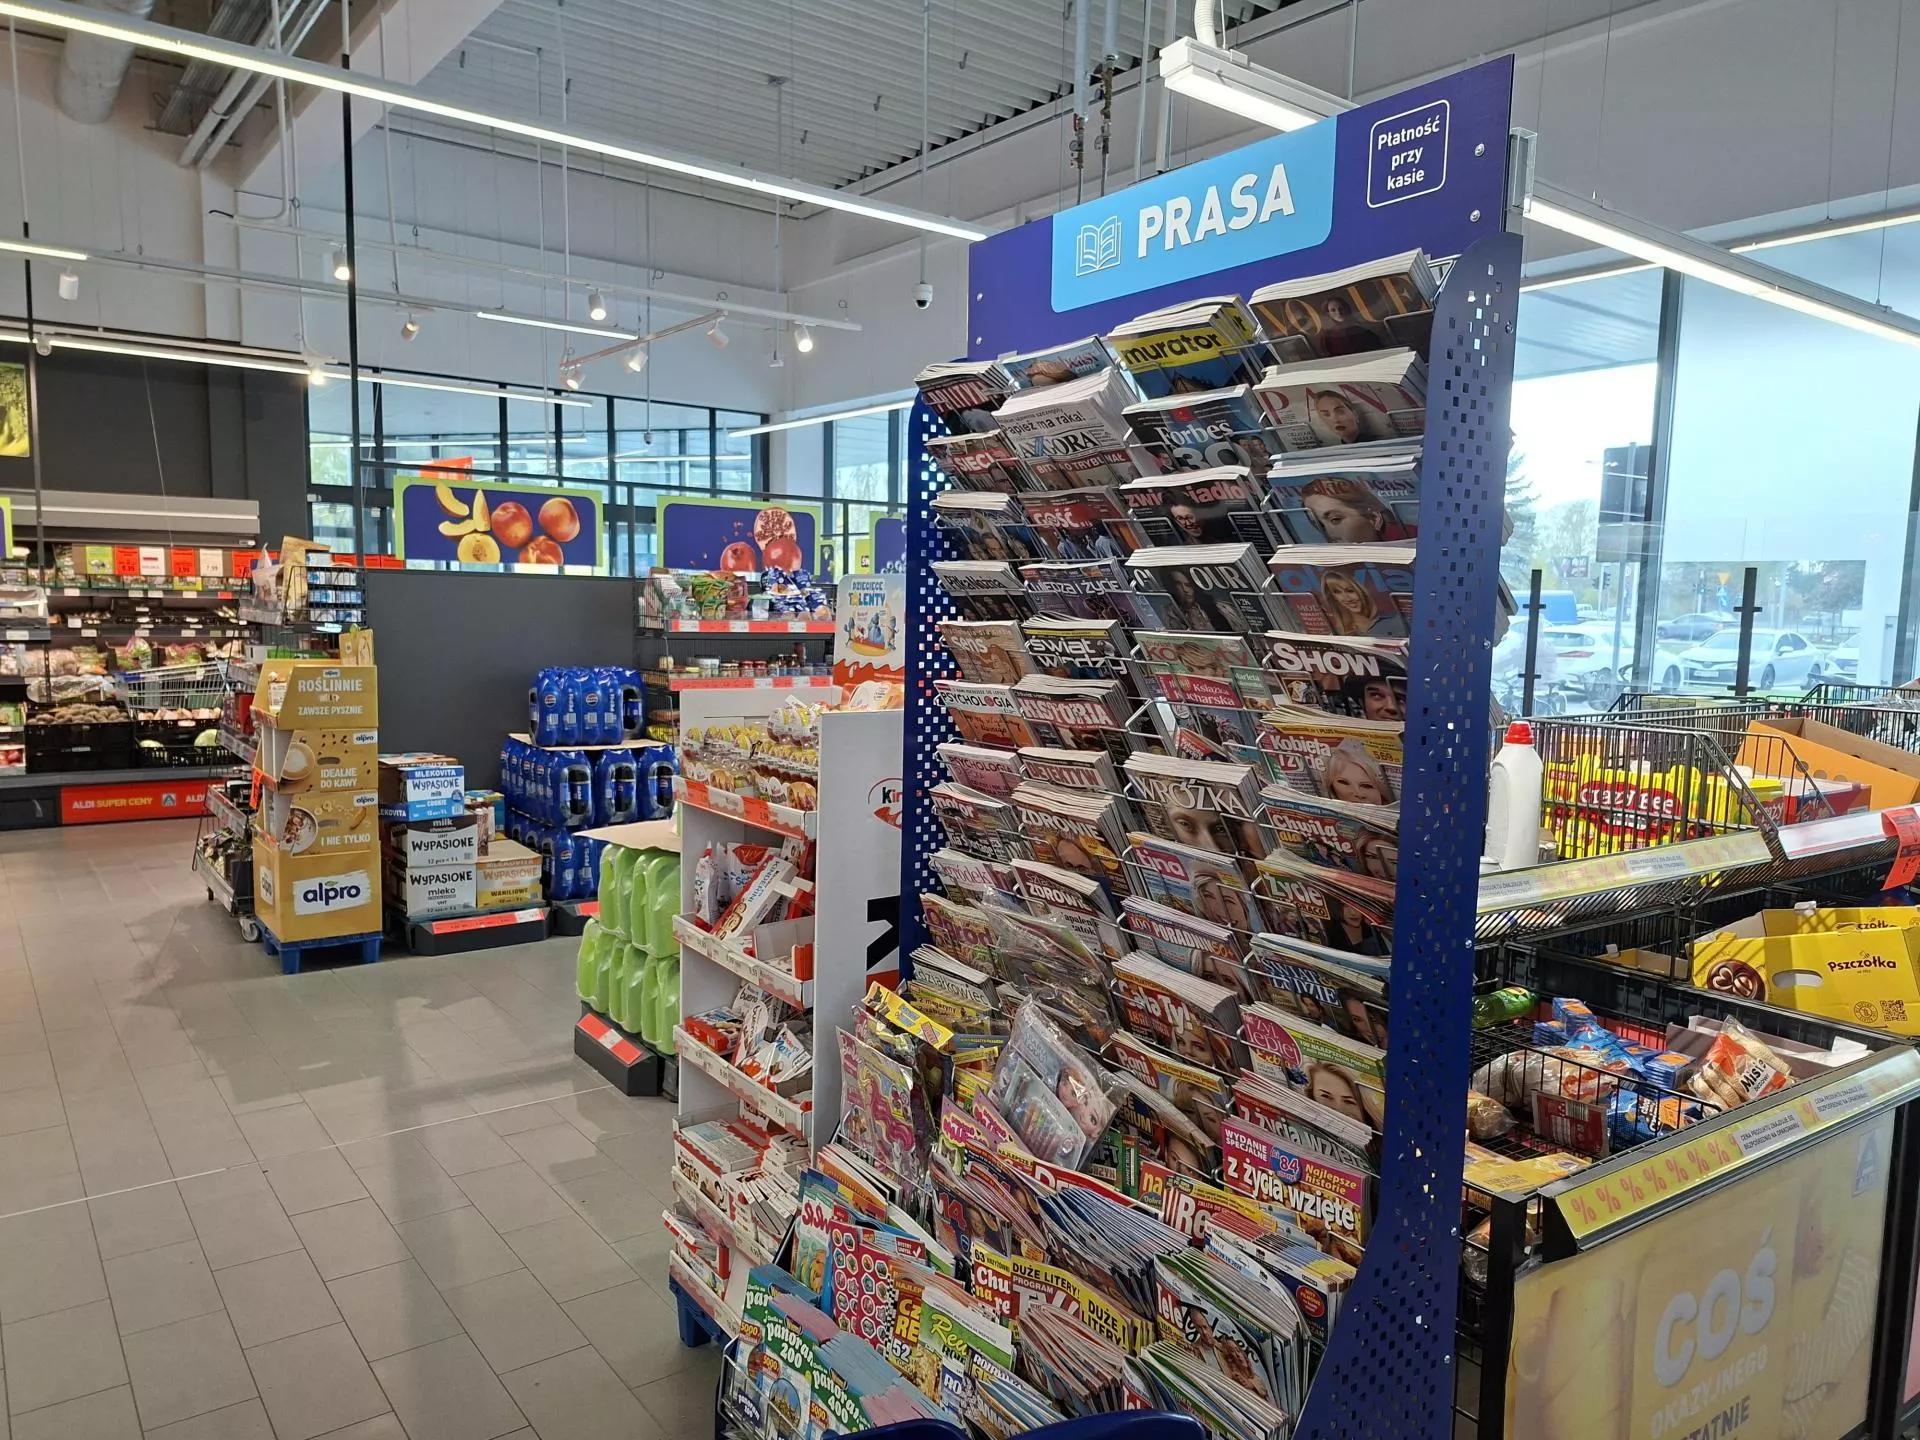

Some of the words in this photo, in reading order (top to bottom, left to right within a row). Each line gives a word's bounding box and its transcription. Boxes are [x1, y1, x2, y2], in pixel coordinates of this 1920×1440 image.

[1377, 114, 1440, 150] Płatność
[1391, 147, 1423, 171] przy
[1387, 168, 1425, 190] kasie
[1137, 163, 1296, 259] PRASA
[1256, 274, 1433, 337] VOUE
[1124, 331, 1222, 366] murator
[926, 381, 997, 413] POLITYK
[1001, 419, 1037, 438] Papież
[1038, 418, 1055, 431] ma
[1056, 409, 1087, 428] raka!
[1153, 420, 1233, 450] Forbes
[955, 452, 995, 473] SIECI
[1033, 507, 1080, 529] GOŚĆ
[951, 636, 988, 654] sens
[1273, 642, 1381, 677] SHOW
[298, 677, 363, 693] ROŚLINNIE
[298, 706, 330, 716] ZAWSZE
[331, 705, 364, 715] PYSZNIE
[1019, 698, 1115, 726] HISTORIA
[355, 733, 375, 743] alpro
[1270, 735, 1332, 757] Kobieta
[320, 767, 357, 778] IDEALNE
[415, 769, 457, 778] MLEKOVITA
[949, 756, 1013, 773] PSYCHOLOGIA
[1027, 763, 1100, 786] DETEKTYW
[320, 779, 332, 788] DO
[333, 778, 358, 788] KAWY
[72, 800, 95, 809] ALDI
[96, 799, 127, 808] SUPER
[128, 797, 153, 806] CENY
[356, 796, 375, 805] alpro
[1138, 775, 1251, 818] WRÓŻKA
[380, 808, 407, 817] EKOVITA
[432, 818, 453, 827] milk
[1016, 805, 1107, 842] ZDROWIE
[1272, 814, 1338, 837] Chwila
[326, 835, 341, 846] NIE
[343, 833, 371, 844] TYLKO
[1137, 847, 1186, 879] tina
[428, 887, 456, 897] mleko
[747, 860, 781, 903] KINDERINI
[1265, 872, 1324, 906] Życie
[302, 882, 361, 906] alpro
[1027, 882, 1093, 912] ZDROWIE
[739, 988, 759, 1004] bueno
[1246, 1024, 1301, 1064] lepiej
[1117, 1047, 1151, 1077] Pani
[1225, 1128, 1268, 1155] WYDANIE
[1225, 1137, 1268, 1163] SPECJALNE
[1279, 1156, 1299, 1173] 84
[1305, 1163, 1358, 1190] Najlepsze
[1143, 1172, 1163, 1196] na
[1227, 1154, 1239, 1178] z
[1243, 1159, 1284, 1201] życia
[1288, 1182, 1356, 1230] wzięte
[1305, 1173, 1347, 1196] historie
[974, 1247, 986, 1264] 63
[1012, 1263, 1041, 1280] DUŻE
[1044, 1272, 1081, 1300] LITERY!
[1013, 1275, 1054, 1295] PROGRAM
[975, 1286, 993, 1302] na
[1155, 1279, 1184, 1327] Tele
[1652, 1223, 1778, 1389] COŚ
[1088, 1299, 1118, 1332] DUŻE
[779, 1342, 803, 1369] 200
[892, 1339, 912, 1363] 52
[1651, 1343, 1769, 1440] OKAZYJNEGO
[827, 1395, 850, 1424] 400
